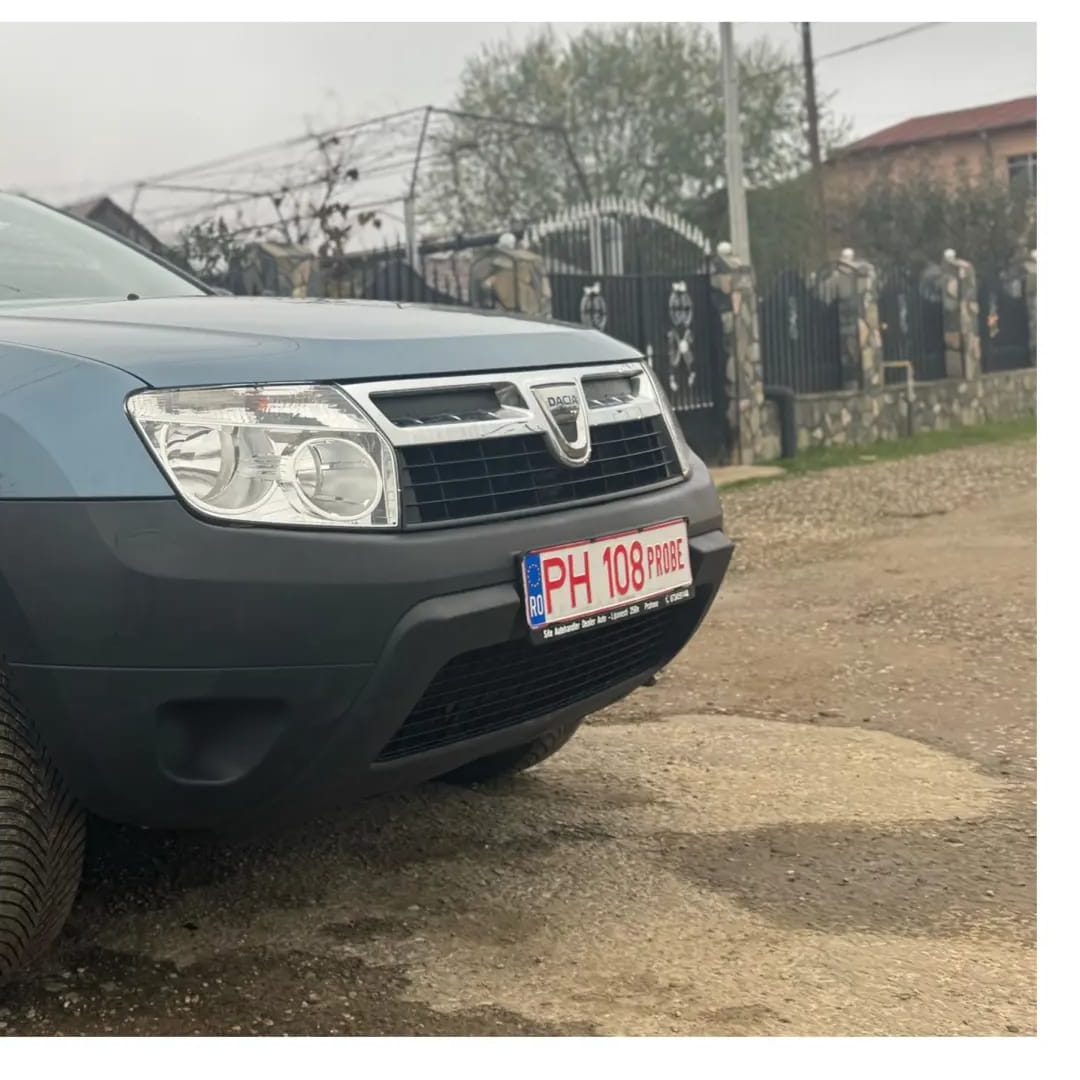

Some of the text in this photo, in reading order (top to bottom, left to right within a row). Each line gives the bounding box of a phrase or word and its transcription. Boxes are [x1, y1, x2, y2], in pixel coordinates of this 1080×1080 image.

[547, 395, 578, 407] DACIA
[543, 538, 685, 614] PH 108 PROBE
[529, 594, 544, 618] RO
